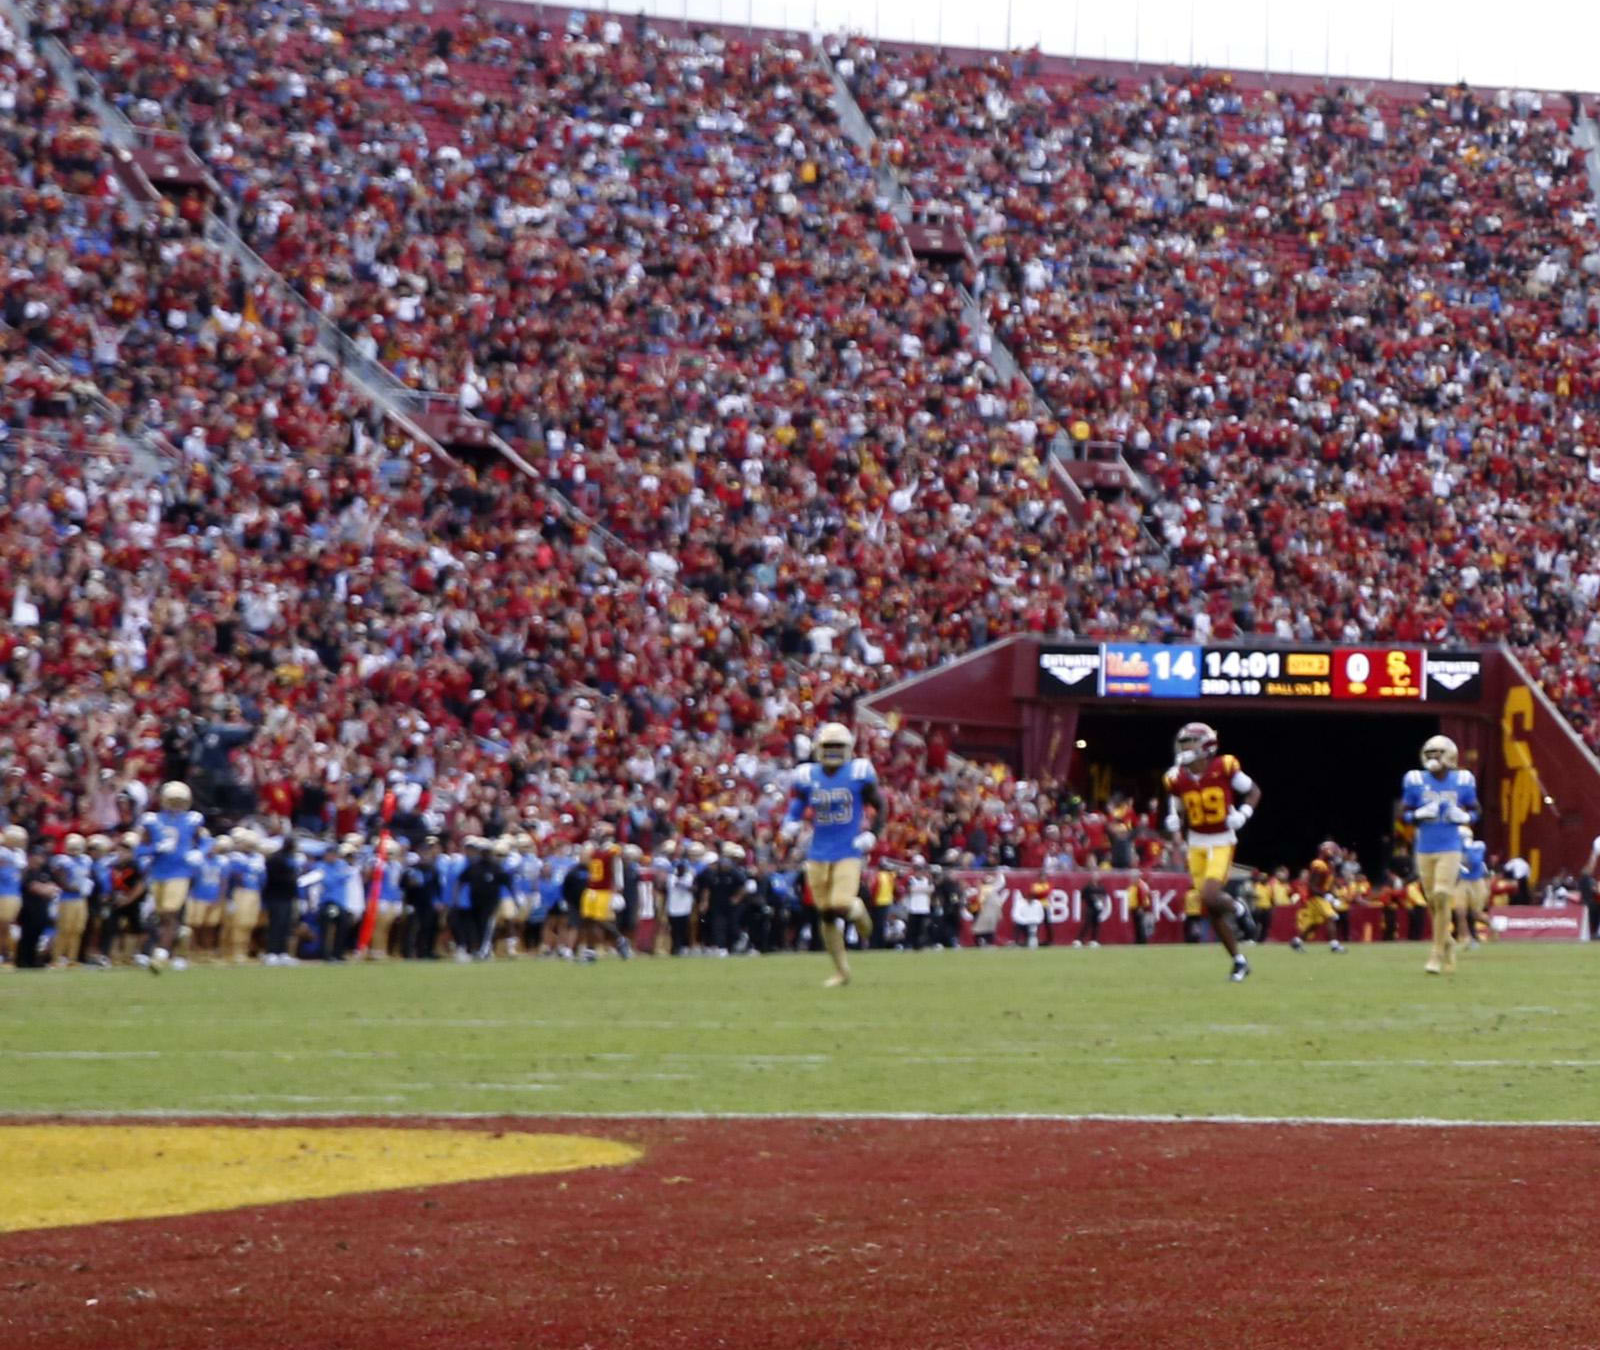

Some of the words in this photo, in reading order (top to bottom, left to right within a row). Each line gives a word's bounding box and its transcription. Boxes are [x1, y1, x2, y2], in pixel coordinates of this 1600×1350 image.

[1152, 651, 1196, 680] 14
[1205, 652, 1280, 678] 14:01
[1346, 653, 1370, 682] 0
[1184, 786, 1226, 826] 89
